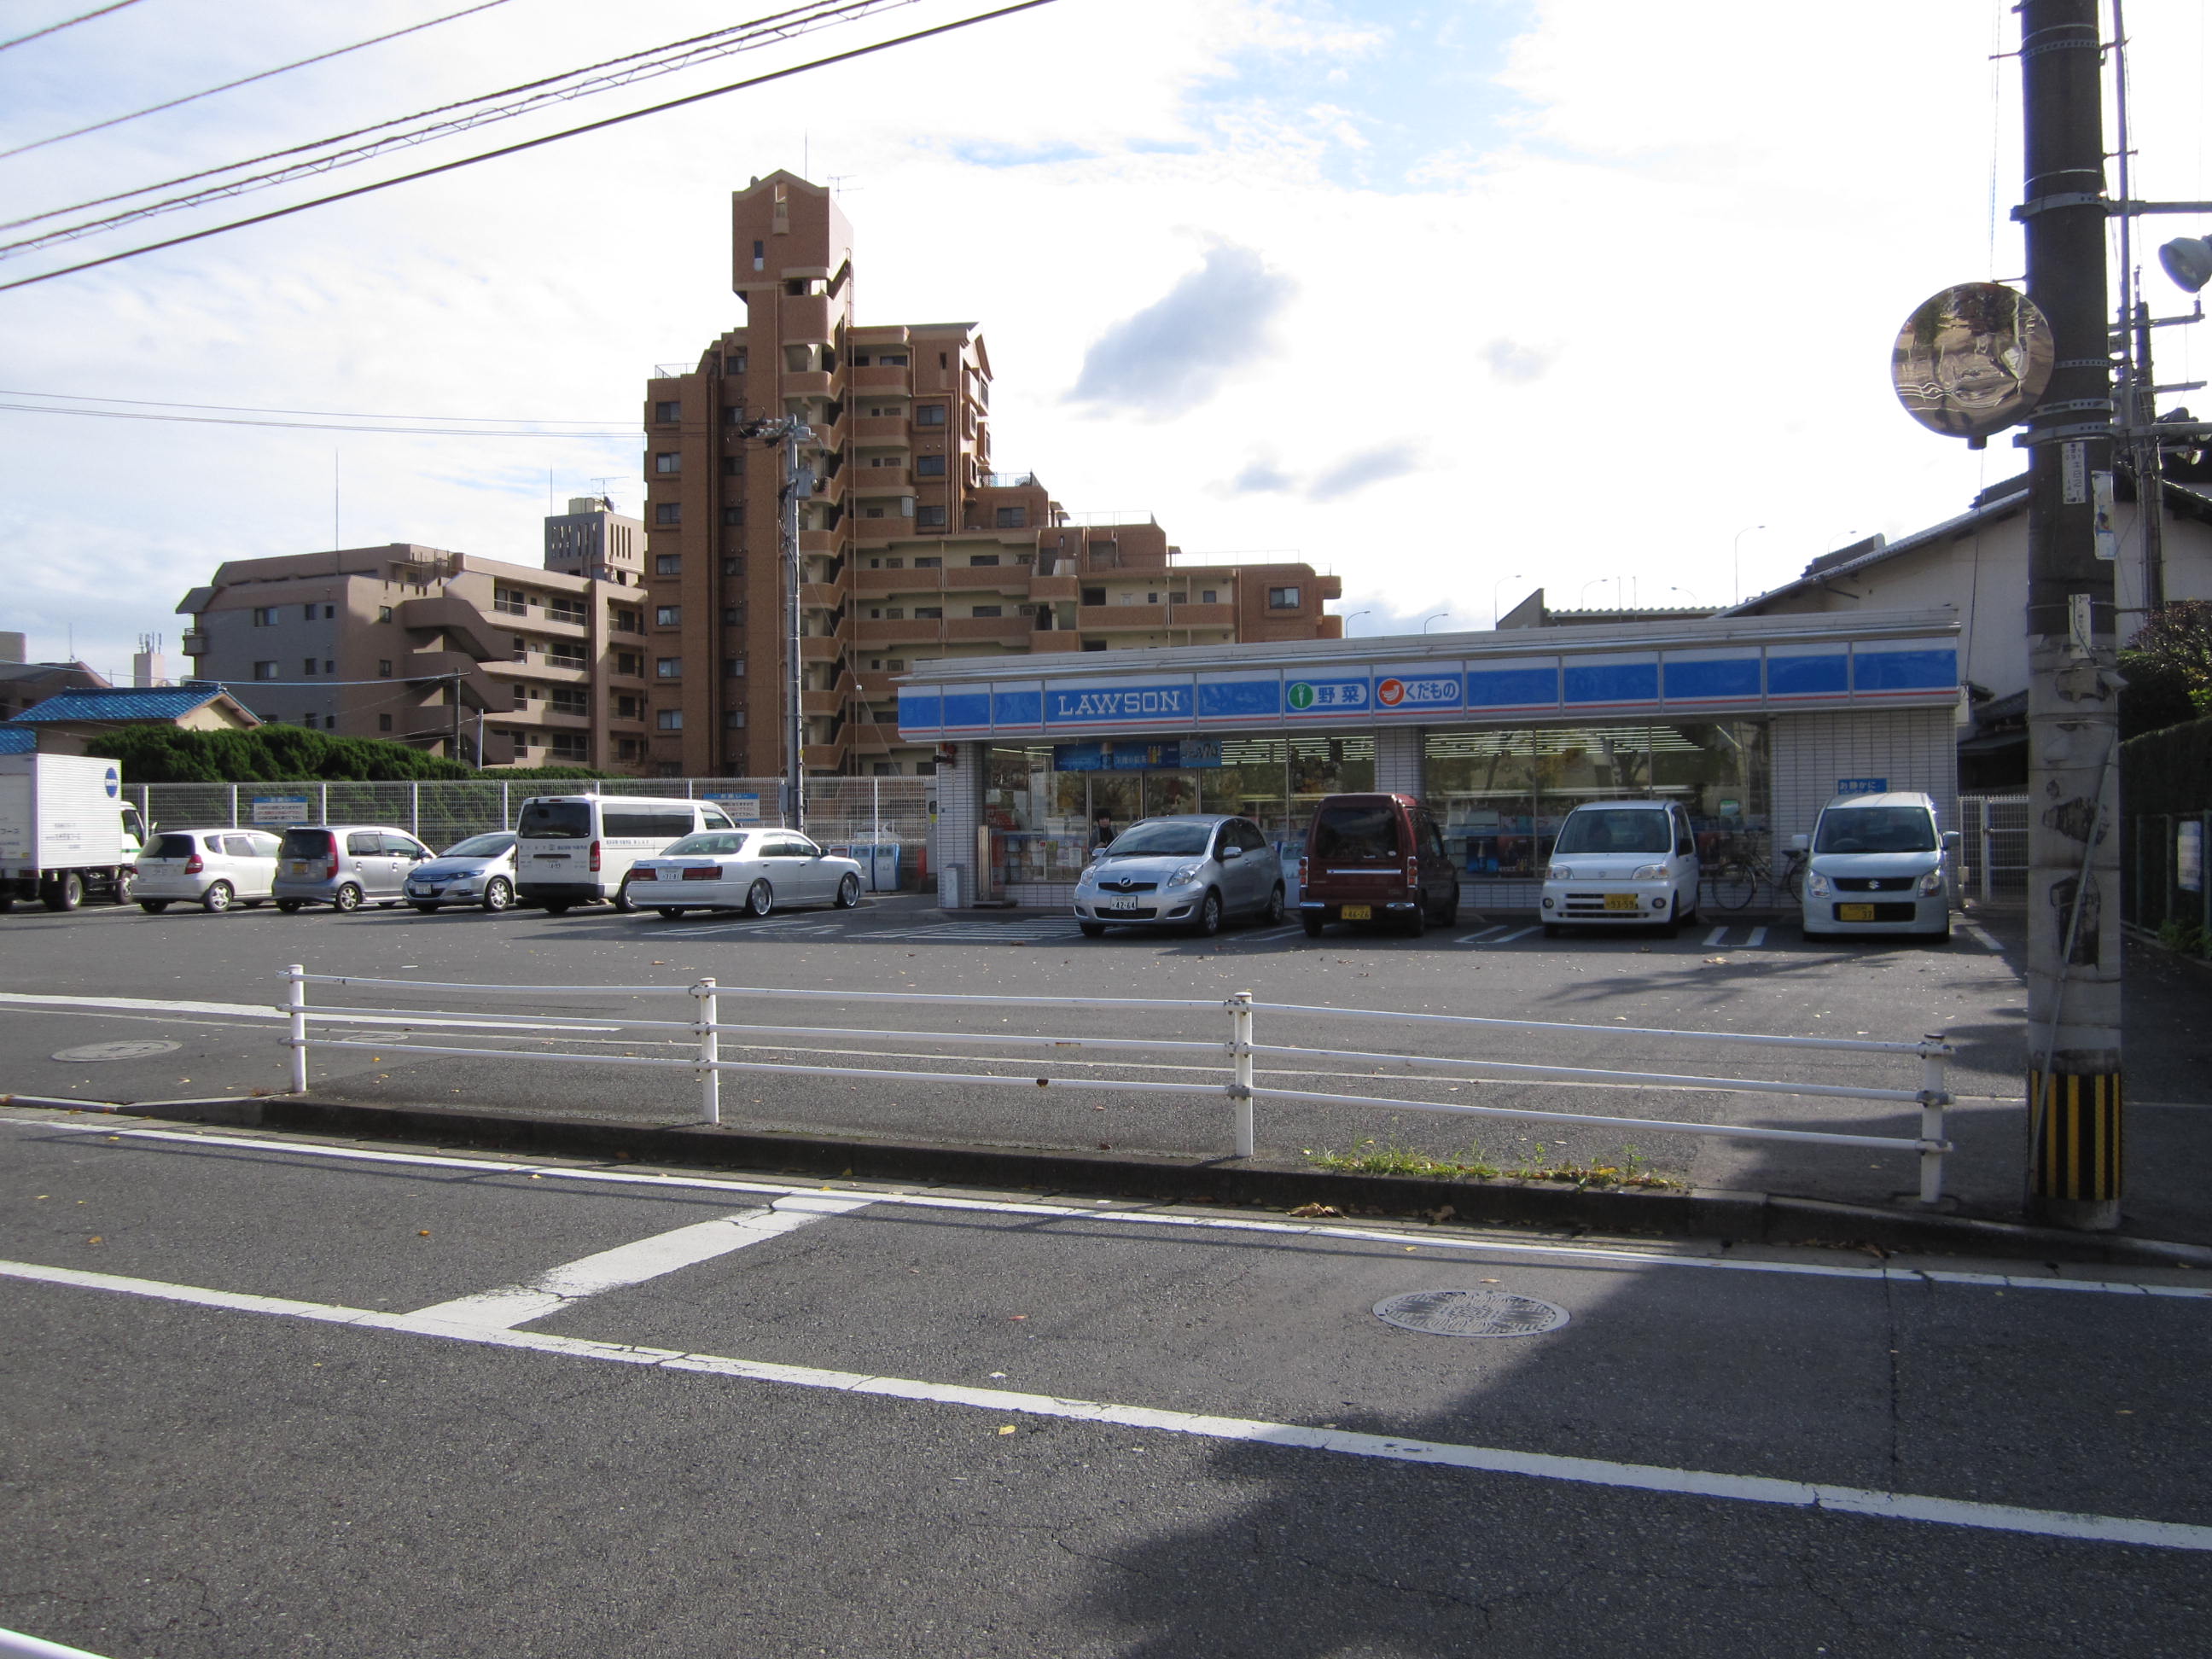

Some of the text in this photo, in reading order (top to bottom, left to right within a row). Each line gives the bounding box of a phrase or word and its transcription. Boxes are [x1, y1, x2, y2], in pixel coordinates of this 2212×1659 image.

[1318, 685, 1359, 703] 野菜
[1406, 683, 1456, 700] くだもの
[1058, 690, 1180, 716] LAWSON
